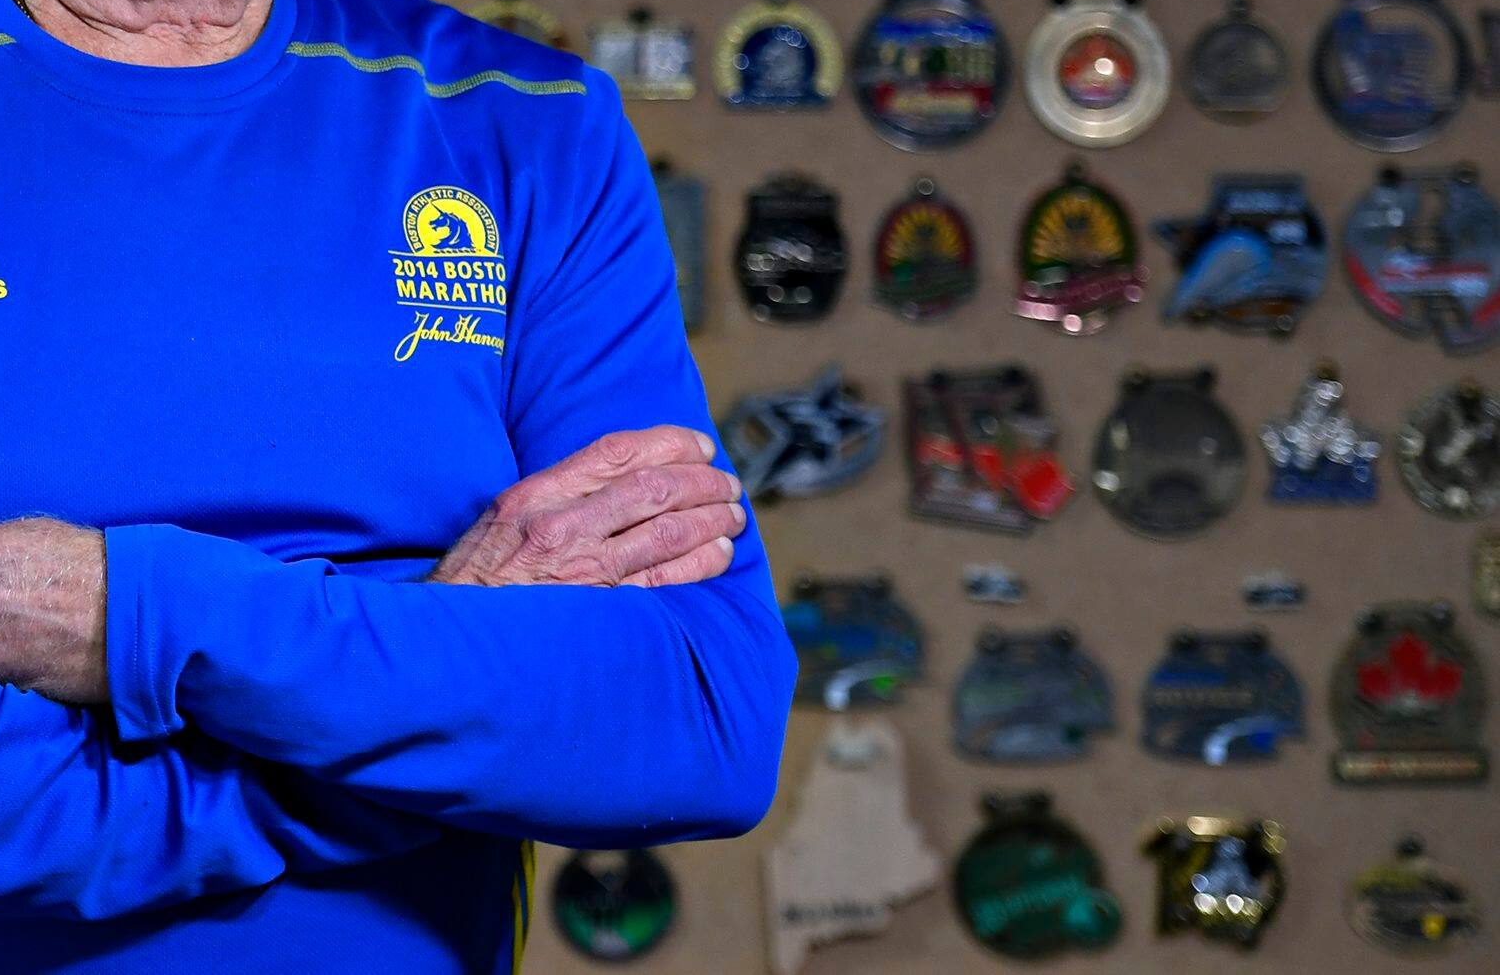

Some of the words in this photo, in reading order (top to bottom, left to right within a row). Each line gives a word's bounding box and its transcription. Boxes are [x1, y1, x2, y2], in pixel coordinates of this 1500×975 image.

[411, 189, 454, 213] ATHLETIC
[406, 211, 423, 250] BOSTON
[455, 191, 497, 250] ASSOCIATION
[392, 258, 439, 279] 2014
[443, 260, 506, 282] BOSTO
[396, 278, 507, 306] MARATHO
[394, 311, 451, 362] John
